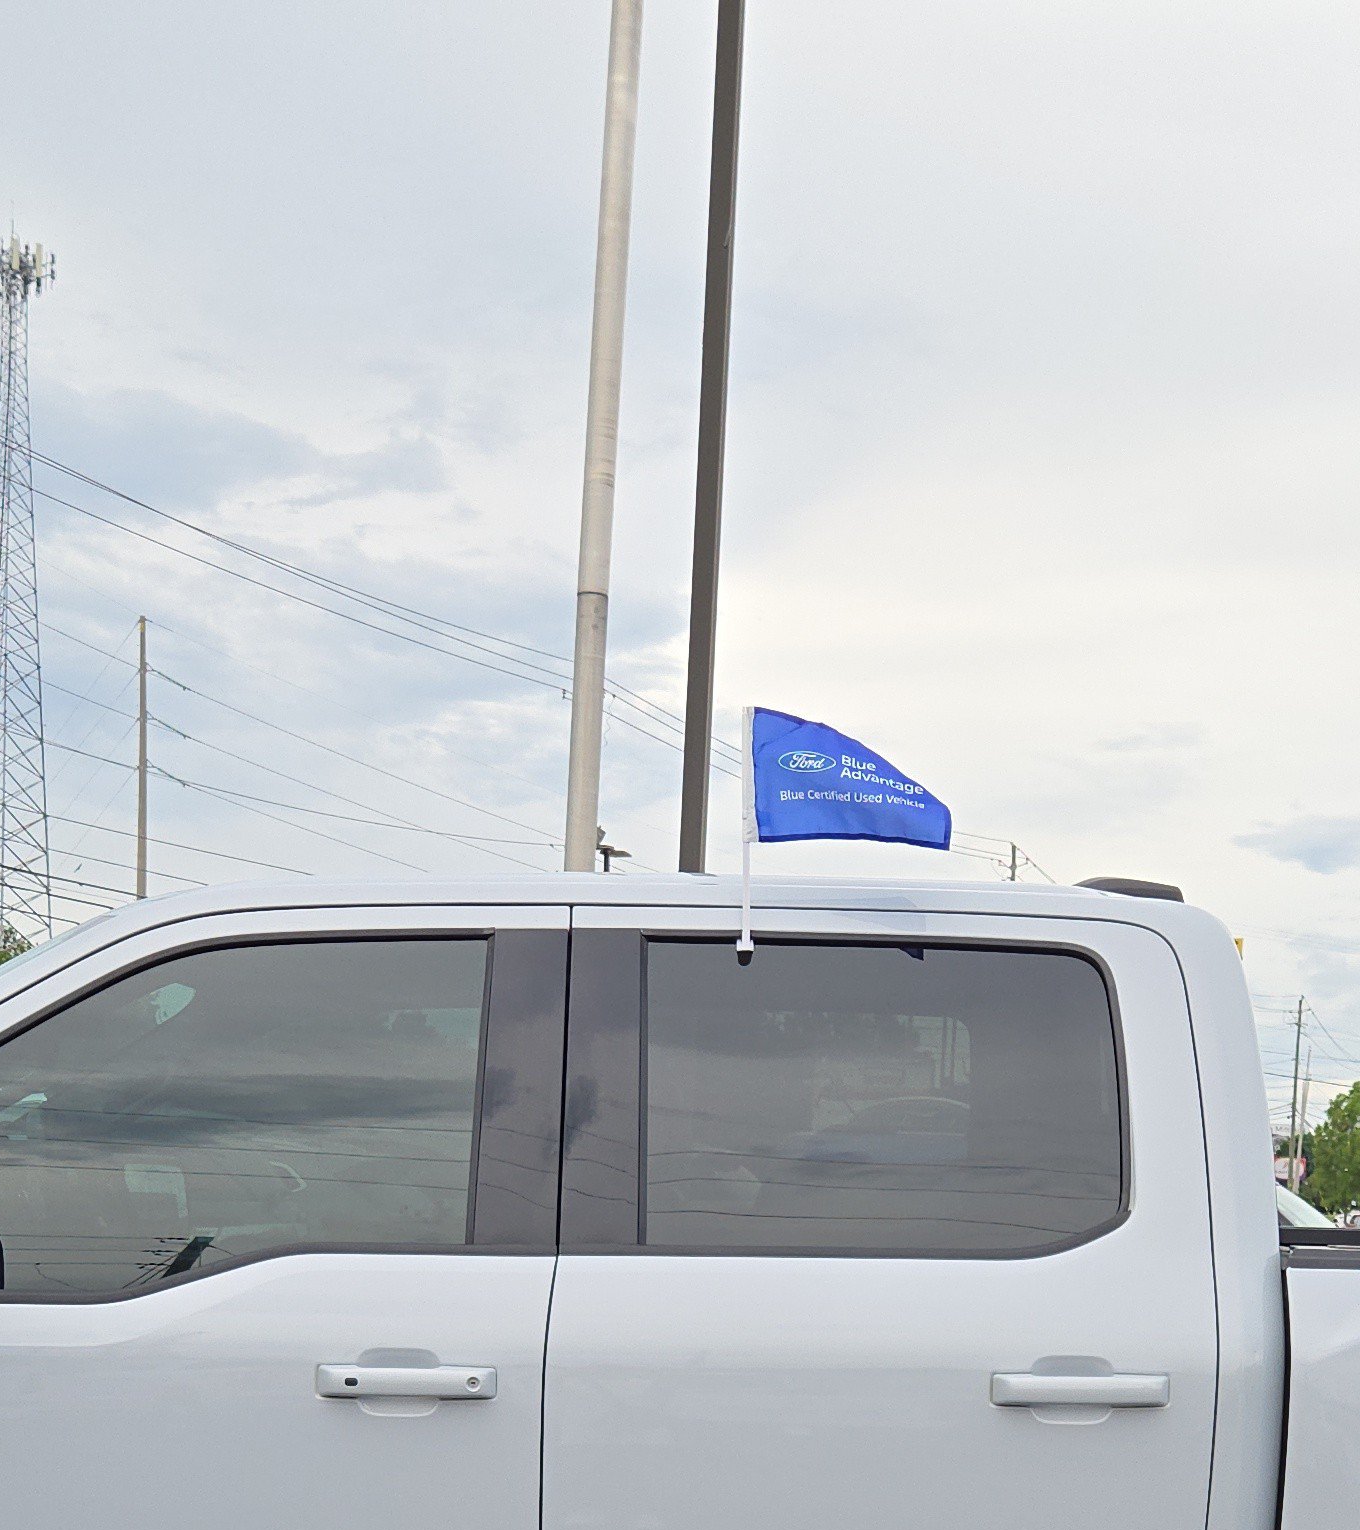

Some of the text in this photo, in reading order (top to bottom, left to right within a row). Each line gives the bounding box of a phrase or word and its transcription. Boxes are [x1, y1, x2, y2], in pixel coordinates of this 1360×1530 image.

[841, 754, 876, 772] Blue
[840, 767, 924, 795] Advantage
[780, 790, 805, 801] Blue
[807, 789, 850, 802] Certified
[854, 792, 882, 804] Used
